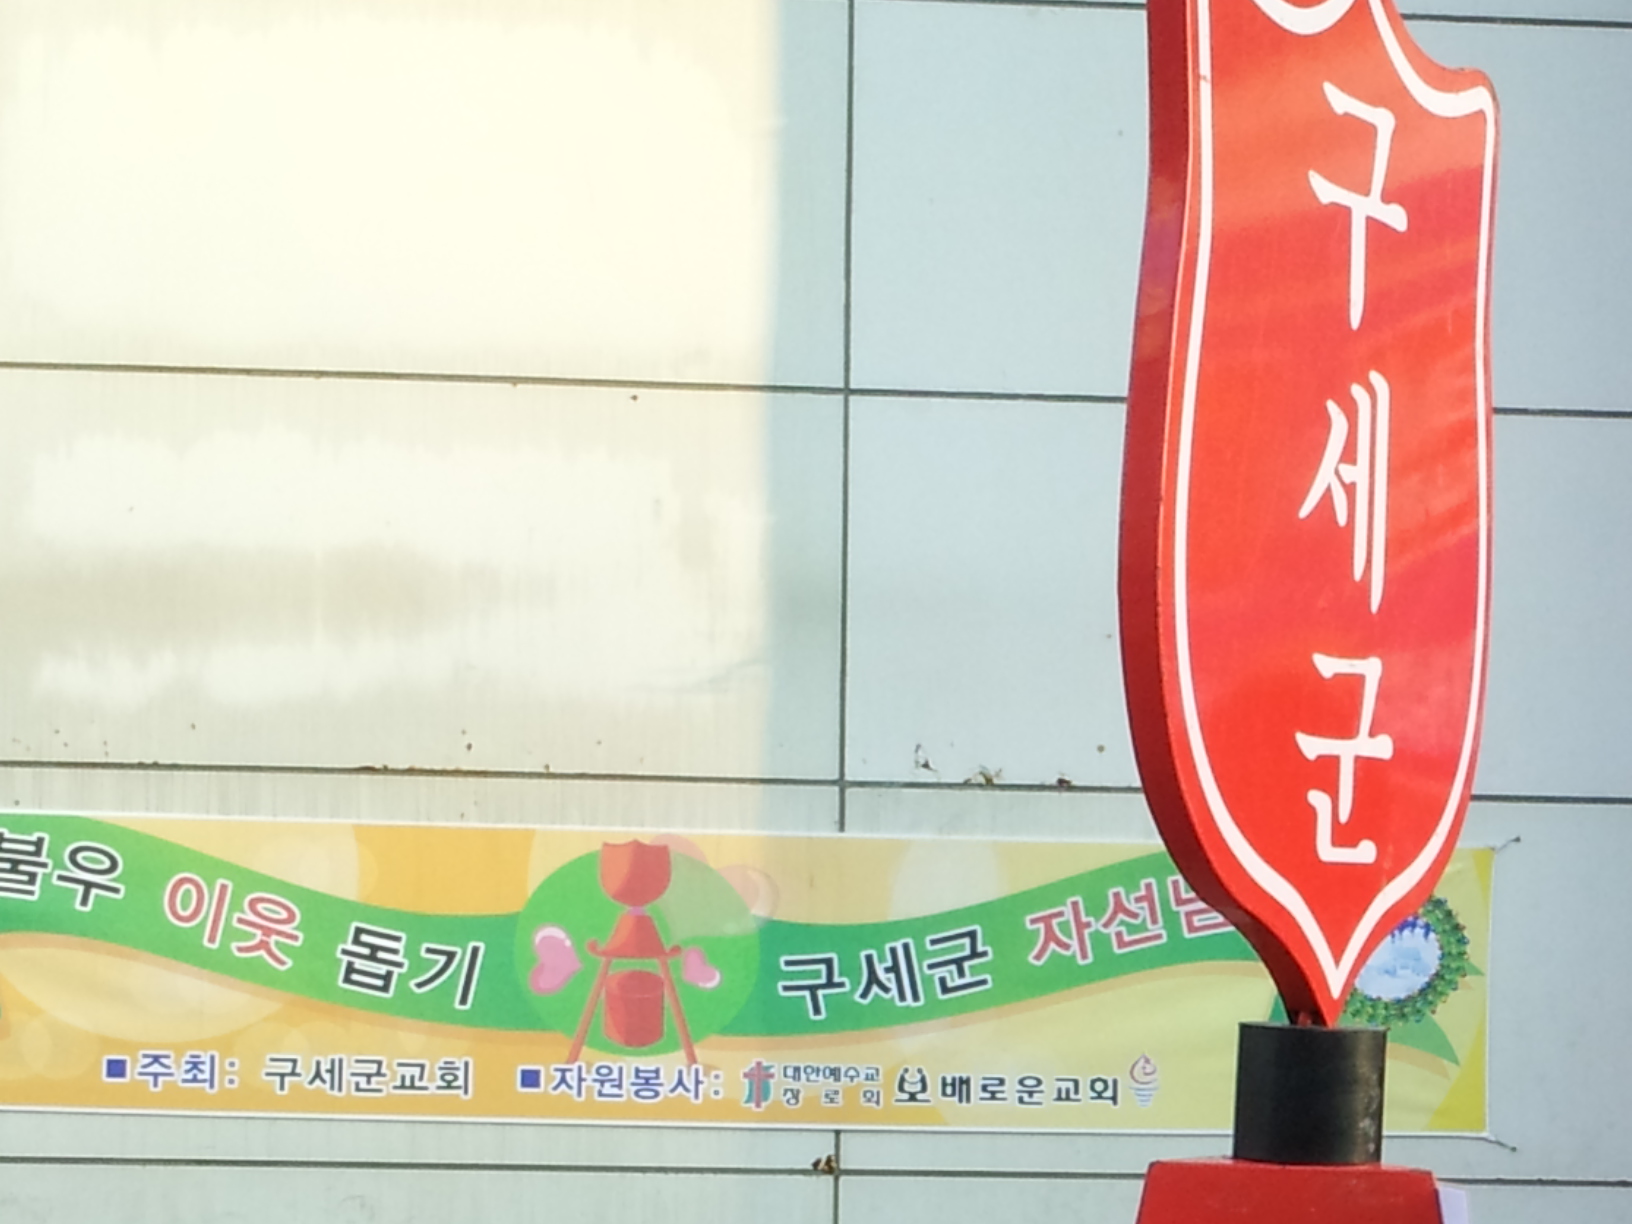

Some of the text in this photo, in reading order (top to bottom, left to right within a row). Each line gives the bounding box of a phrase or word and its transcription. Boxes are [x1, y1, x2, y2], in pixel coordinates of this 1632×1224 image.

[1296, 80, 1408, 866] 구세군
[0, 831, 122, 909] 불우
[166, 875, 301, 967] 이웃
[338, 924, 484, 1008] 돕기
[780, 930, 991, 1018] 구세군
[137, 1054, 472, 1096] 주최: 구세군교회
[550, 1065, 723, 1101] 자원봉사:
